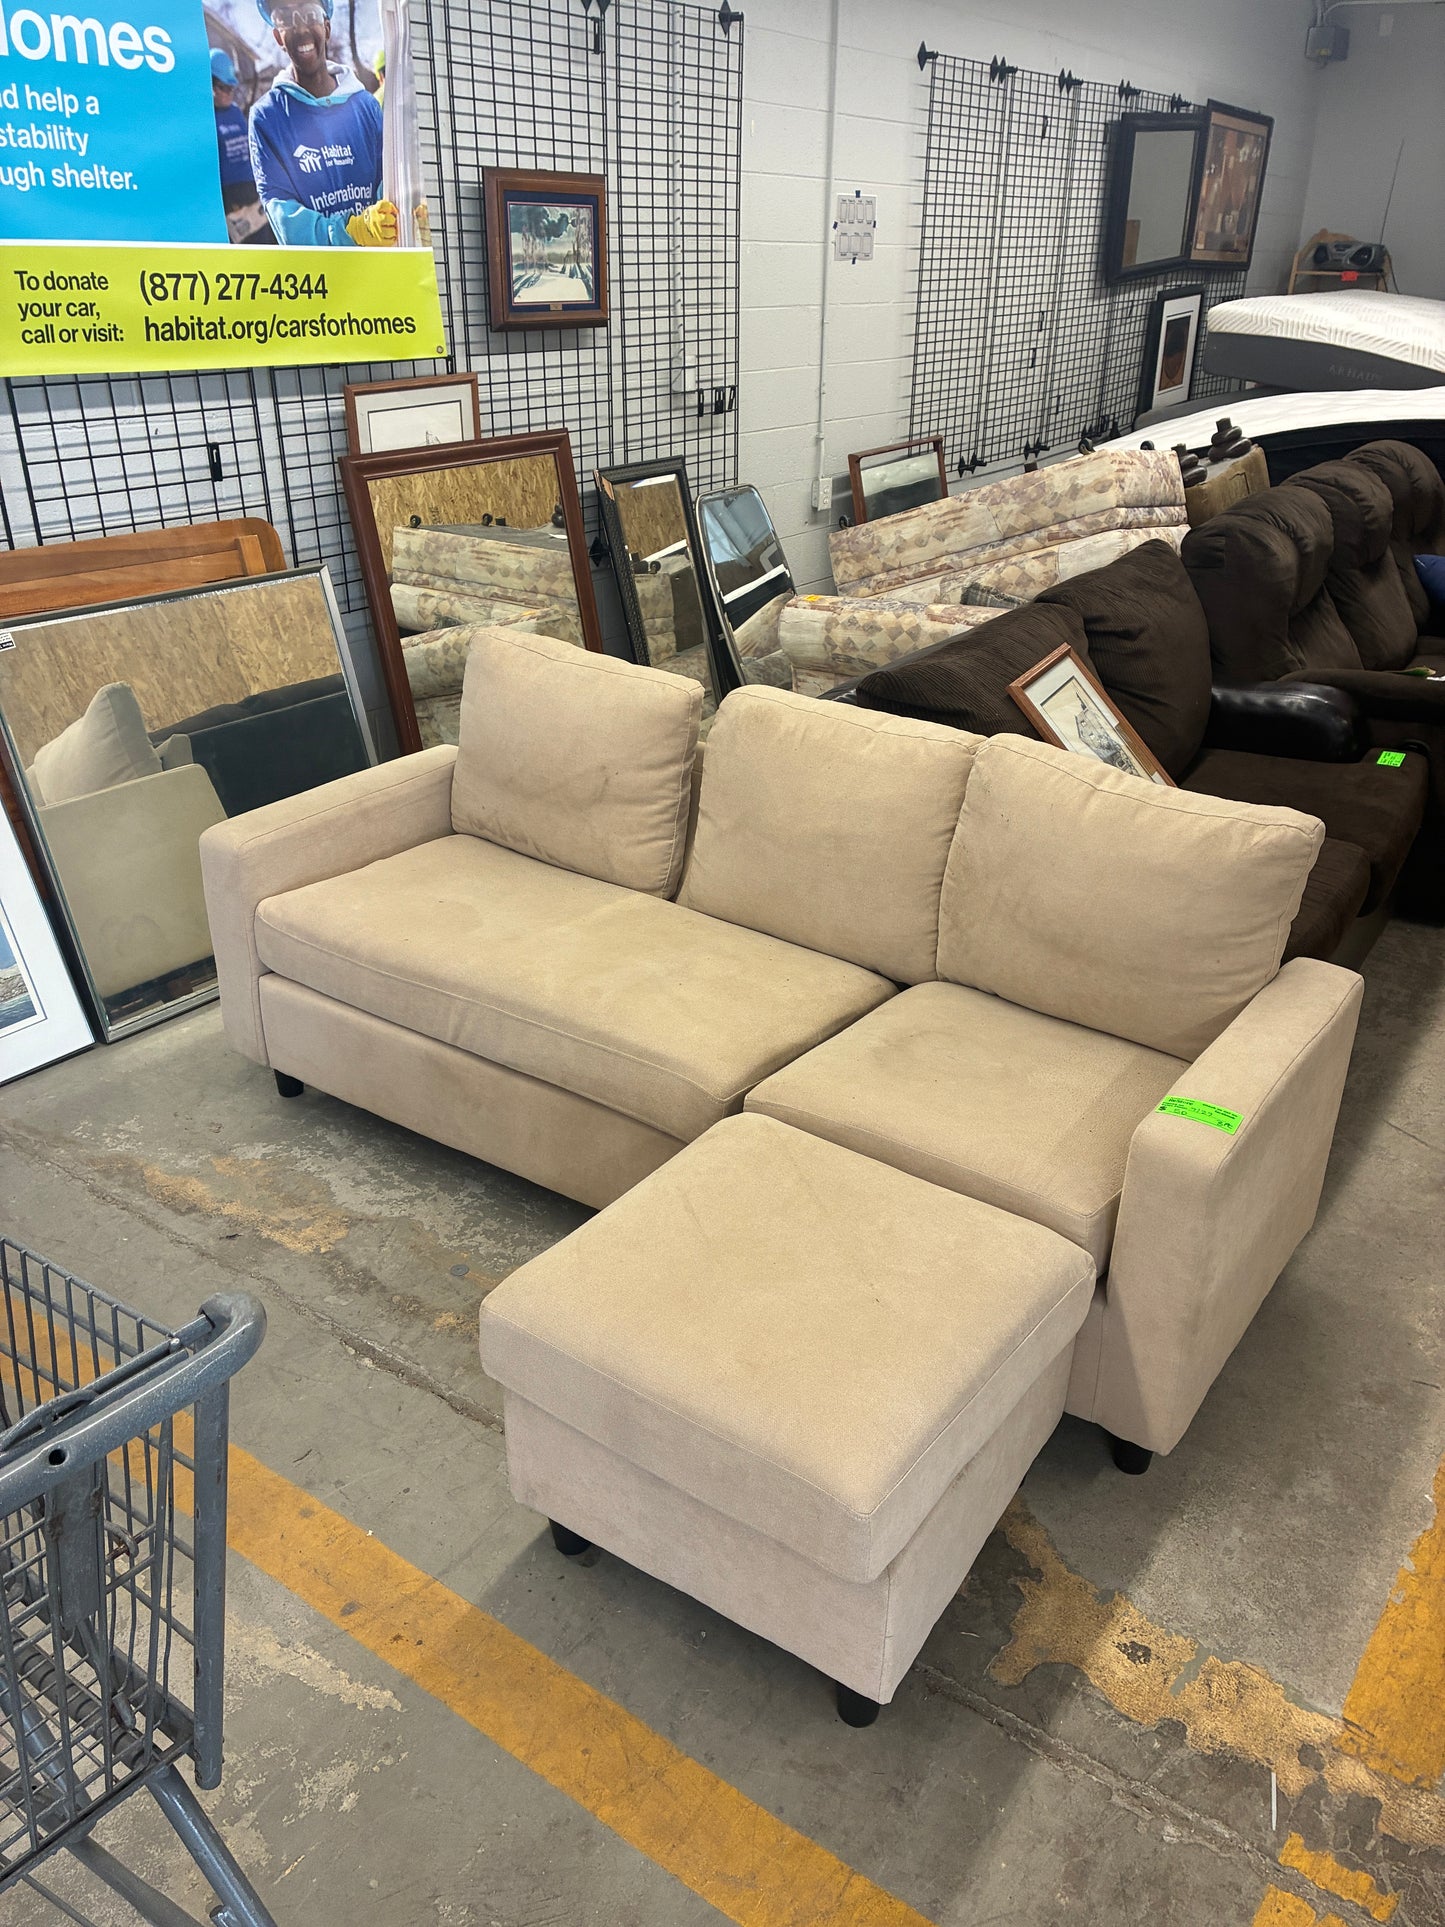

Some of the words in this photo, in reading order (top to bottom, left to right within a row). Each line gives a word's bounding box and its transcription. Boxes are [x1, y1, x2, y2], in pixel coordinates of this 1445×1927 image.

[0, 1, 175, 73] omes
[25, 84, 79, 118] help
[86, 96, 100, 115] a
[0, 122, 88, 156] stability
[321, 144, 352, 160] Habitat
[51, 162, 138, 190] shelter.
[310, 183, 372, 211] International
[14, 271, 40, 291] To
[43, 271, 109, 291] donate
[140, 270, 210, 306] (877)
[215, 273, 328, 301] 277-4344
[18, 302, 62, 322] your
[66, 302, 100, 320] car,
[21, 324, 56, 344] call
[59, 327, 79, 343] or
[82, 323, 124, 342] visit:
[144, 312, 417, 344] habitat.org/carsforhomes
